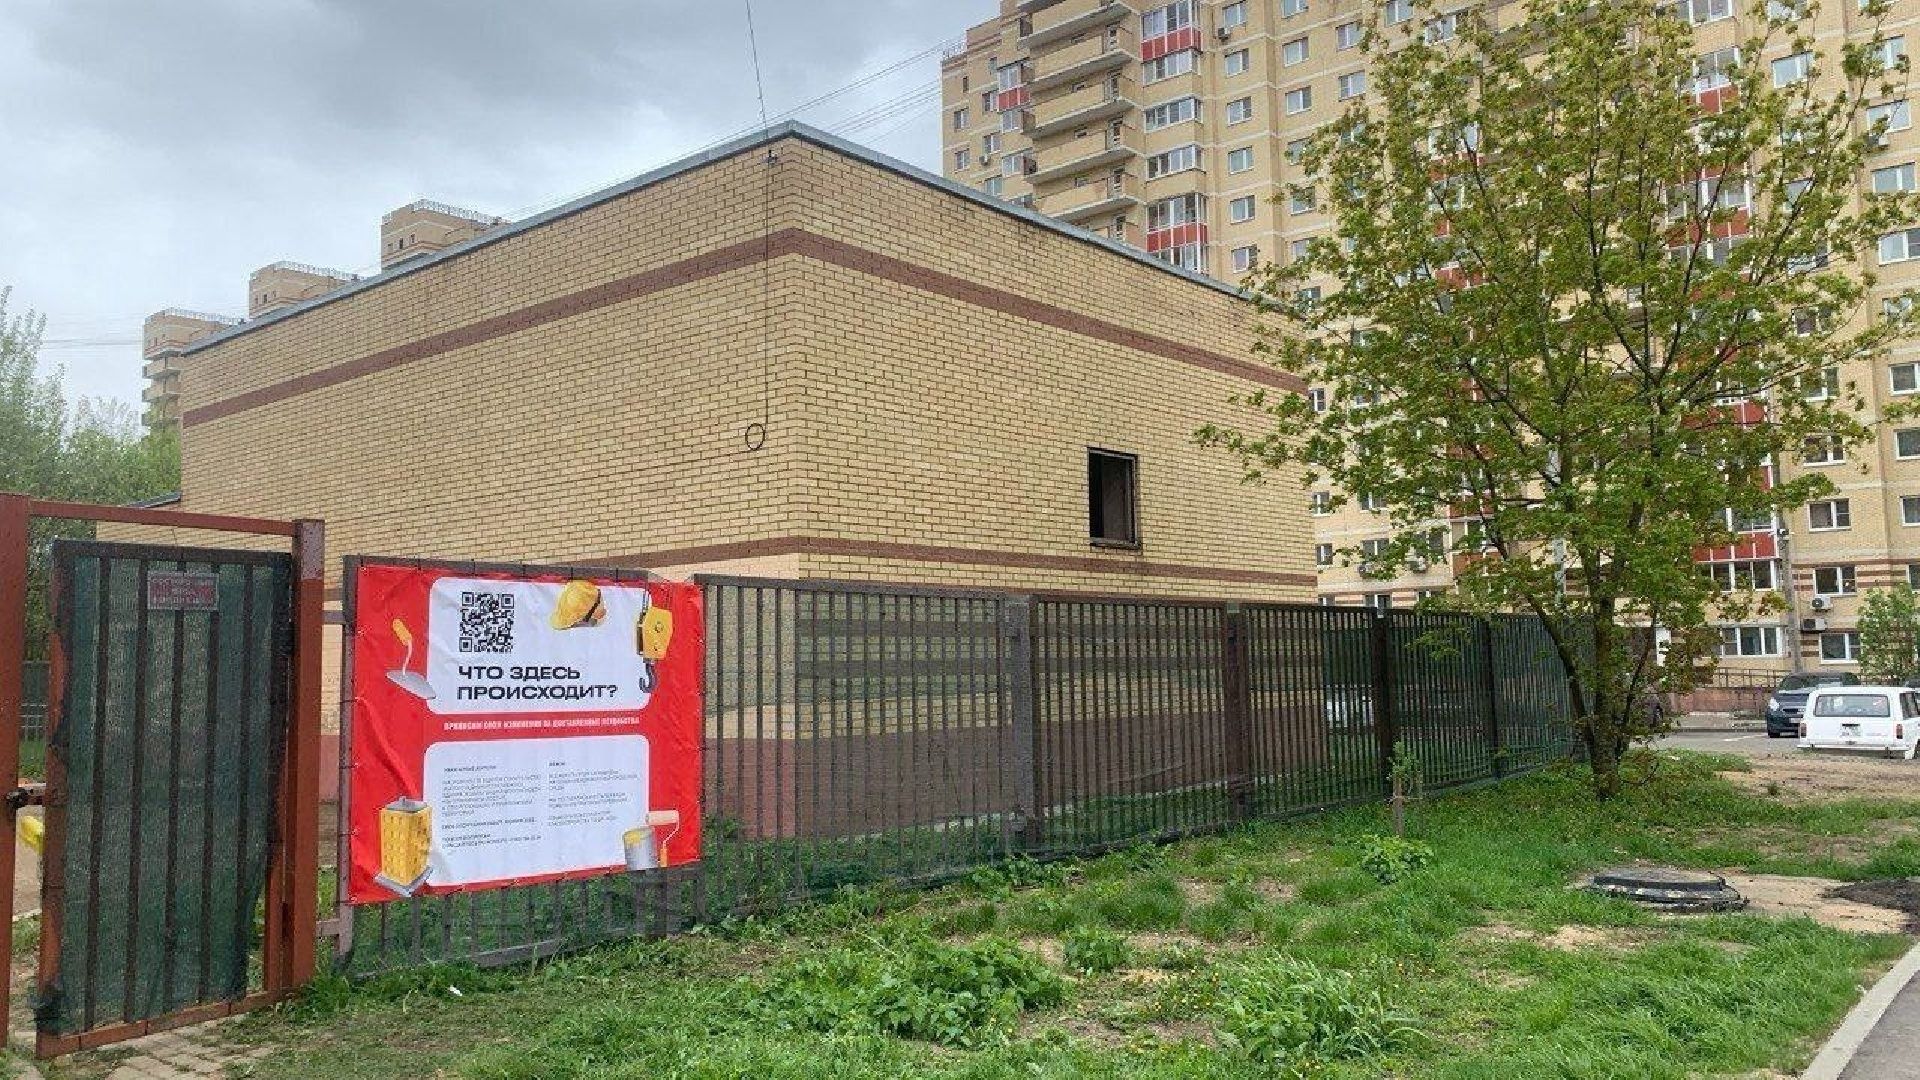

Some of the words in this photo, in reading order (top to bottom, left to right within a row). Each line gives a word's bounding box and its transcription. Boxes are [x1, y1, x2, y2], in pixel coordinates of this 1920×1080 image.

[458, 666, 503, 680] ЧТО
[510, 666, 581, 682] ЗДЕСЬ
[457, 685, 618, 700] ПРОИСХОДИТ?
